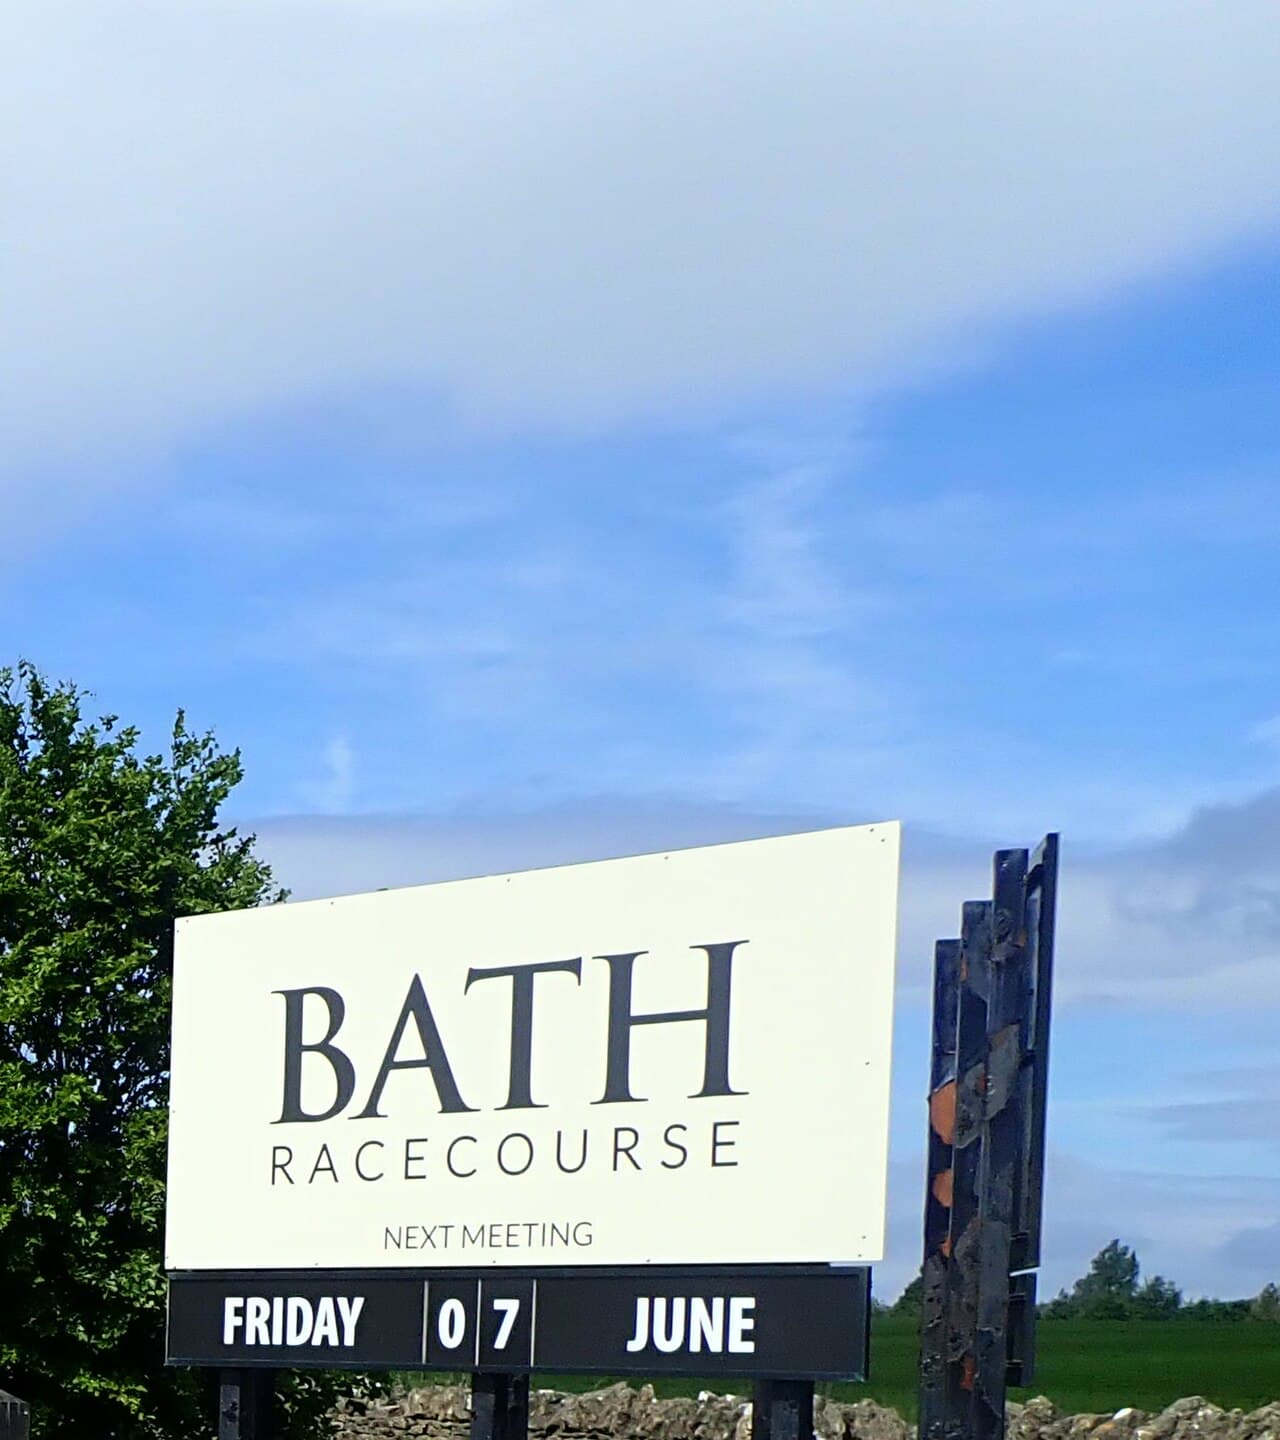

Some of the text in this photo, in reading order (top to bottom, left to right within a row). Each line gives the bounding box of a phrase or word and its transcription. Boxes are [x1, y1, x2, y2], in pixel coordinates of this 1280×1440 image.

[270, 939, 748, 1125] BATH
[270, 1120, 740, 1186] RACECOURSE
[384, 1221, 594, 1250] NEXT MEETING
[223, 1296, 365, 1347] FRIDAY
[626, 1297, 756, 1353] JUNE
